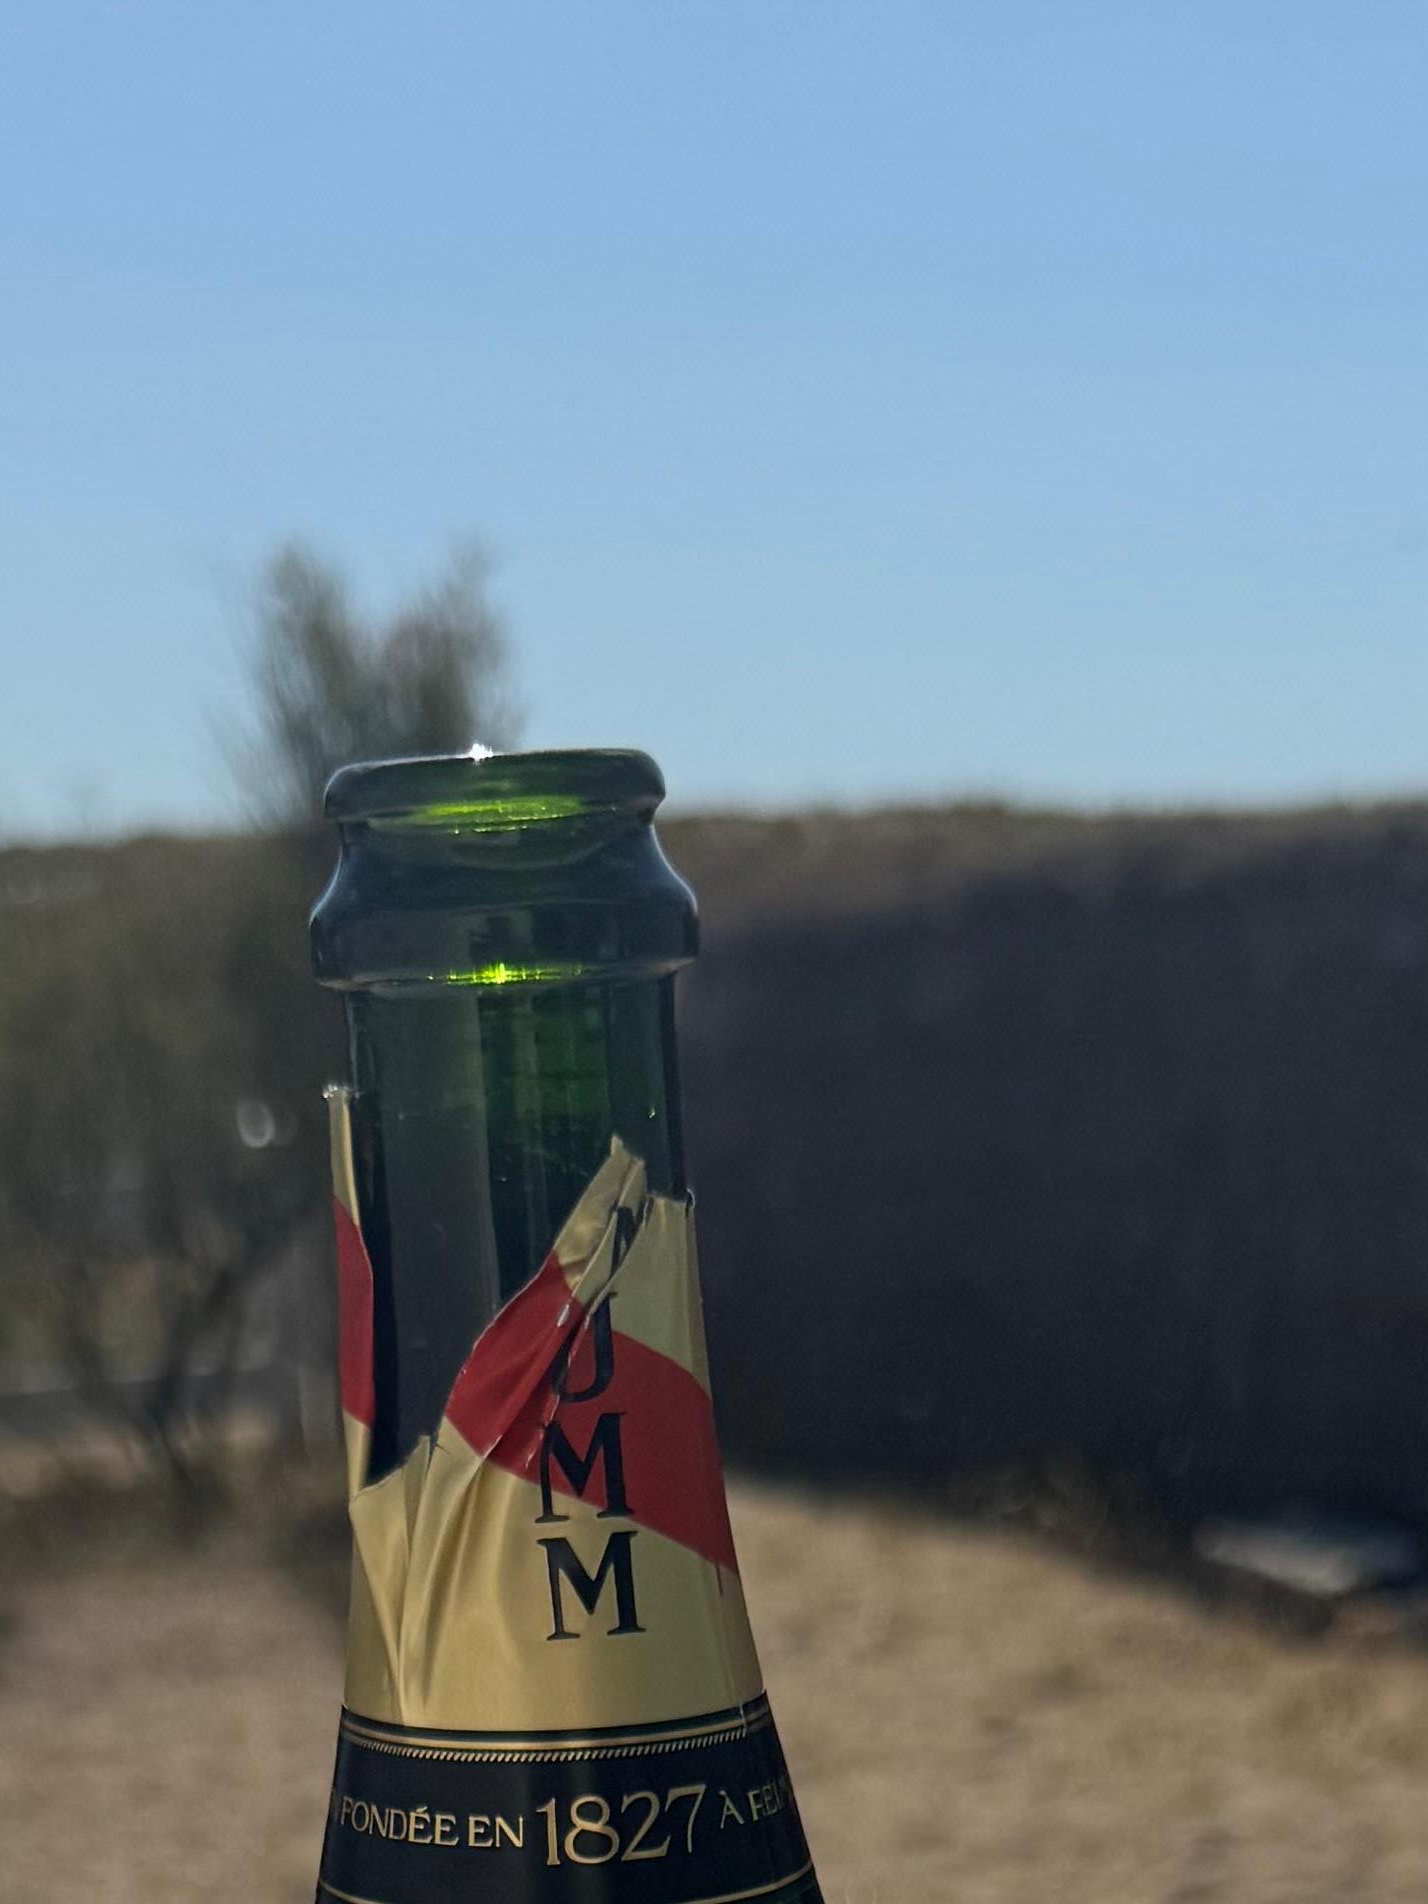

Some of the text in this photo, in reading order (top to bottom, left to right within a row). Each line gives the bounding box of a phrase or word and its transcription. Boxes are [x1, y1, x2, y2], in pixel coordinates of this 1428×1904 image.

[468, 1815, 524, 1848] EN
[535, 1783, 707, 1867] 1827
[719, 1789, 745, 1829] À
